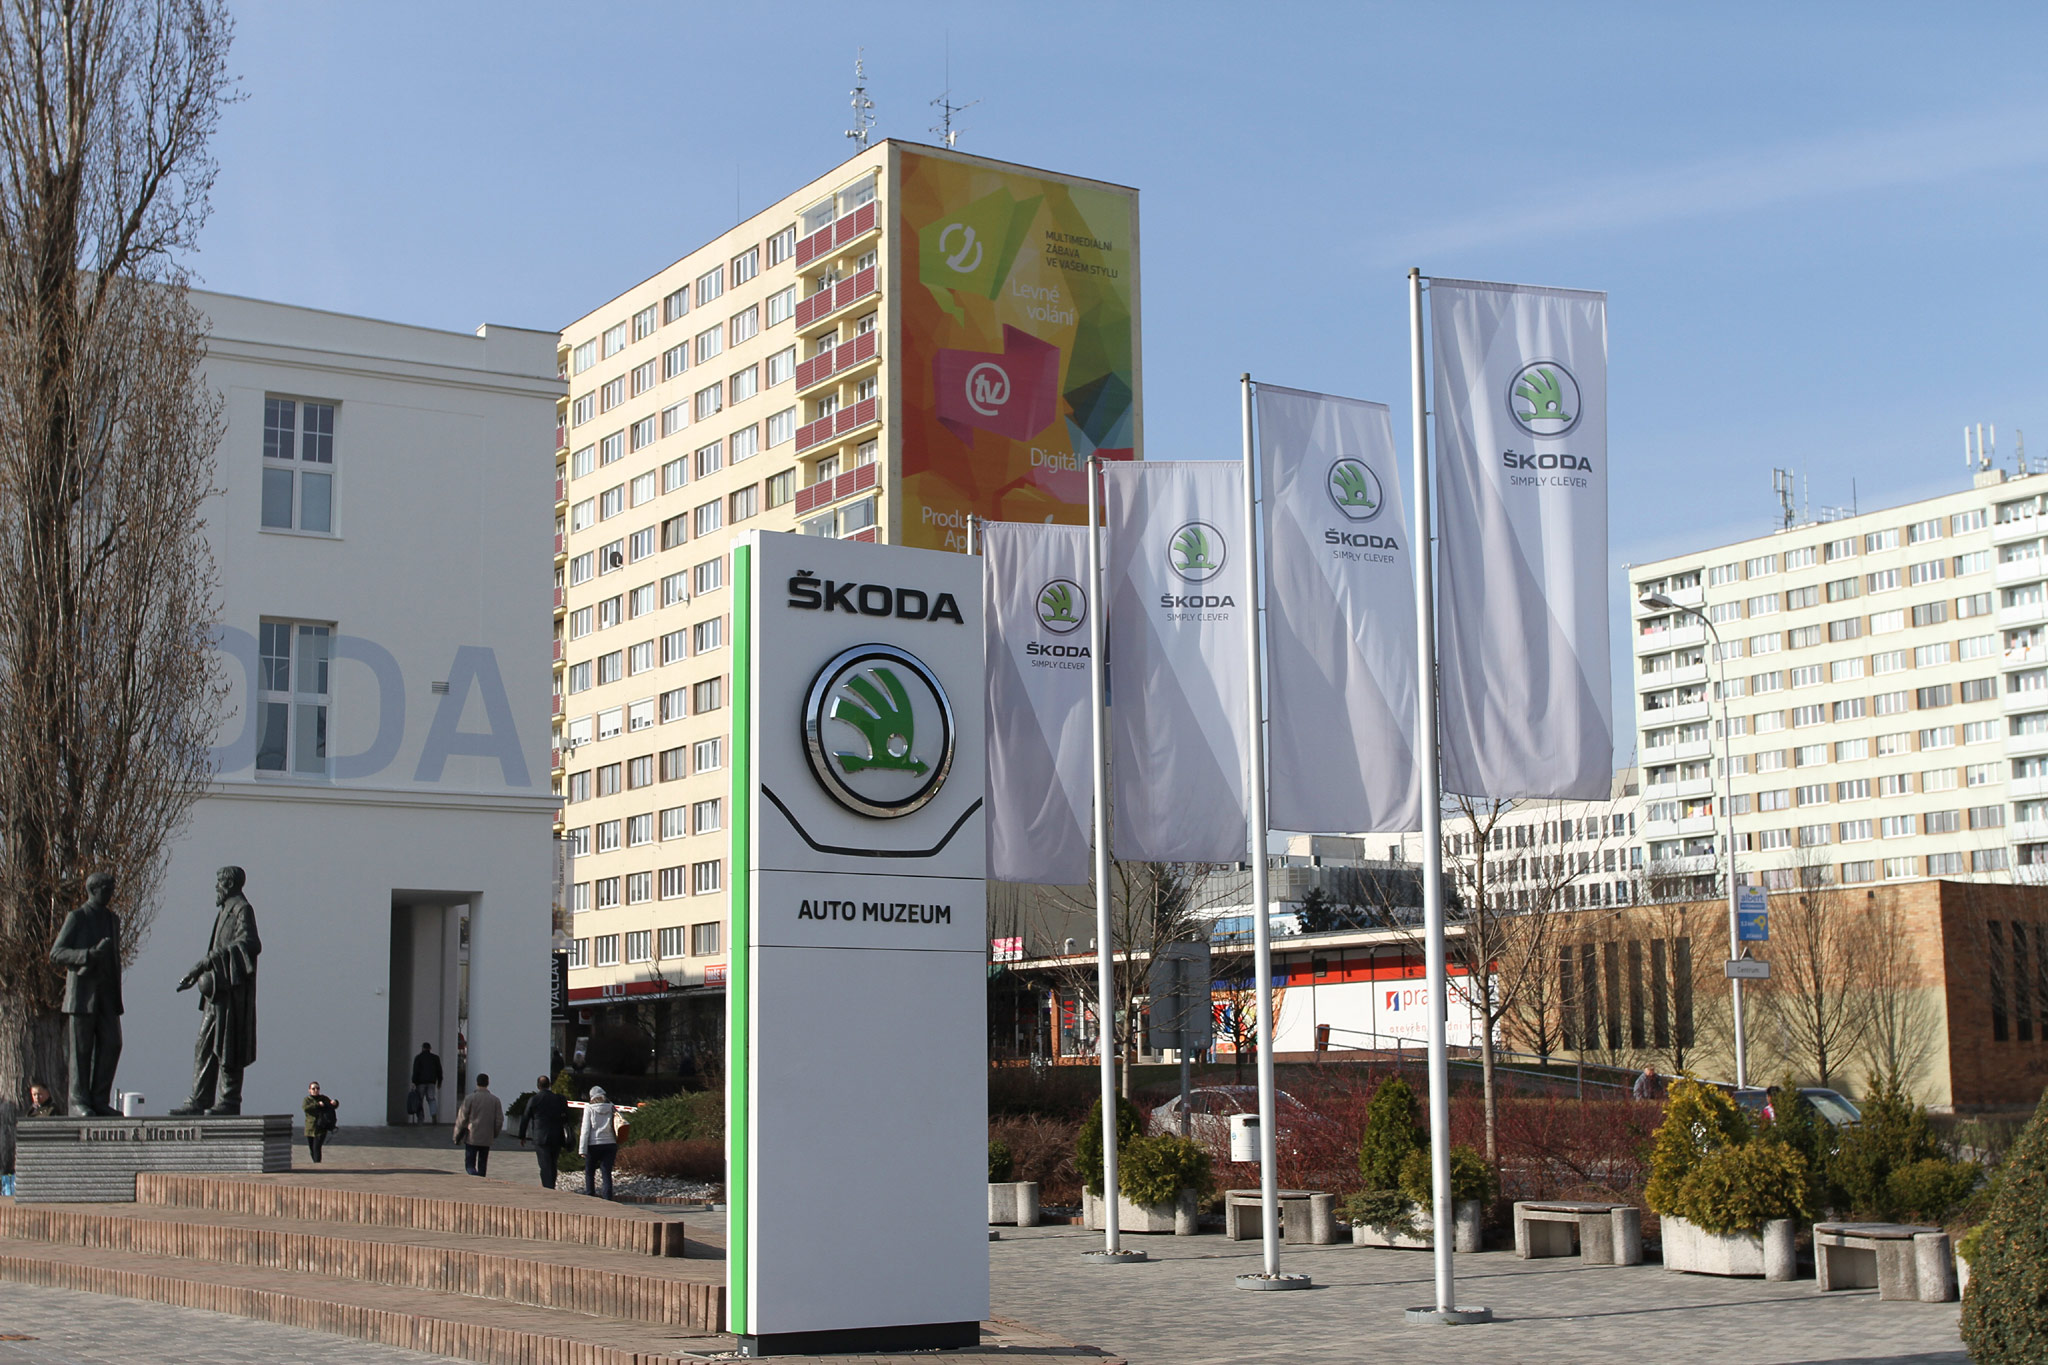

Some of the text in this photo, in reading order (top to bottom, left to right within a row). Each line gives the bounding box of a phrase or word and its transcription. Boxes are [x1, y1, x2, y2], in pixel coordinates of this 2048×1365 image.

[1045, 242, 1080, 259] ZÁBAVA
[1046, 257, 1118, 278] VE VAŠEM STYLU
[1012, 279, 1060, 304] Levné
[1026, 303, 1075, 327] volání
[1502, 449, 1592, 473] ŠKODA
[1510, 475, 1588, 489] SIMPLY CLEVER
[1324, 528, 1399, 550] ŠKODA
[1332, 550, 1395, 564] SIMPLY CLEVER
[788, 569, 964, 625] ŠKODA
[1160, 593, 1235, 608] ŠKODA
[1167, 612, 1229, 622] SIMPLY CLEVER
[1026, 641, 1091, 658] ŠKODA
[1031, 659, 1085, 671] SIMPLY CLEVER
[1741, 893, 1763, 902] albert
[798, 900, 951, 924] AUTO MUZEUM
[86, 1127, 196, 1141] Laurin & Klement
